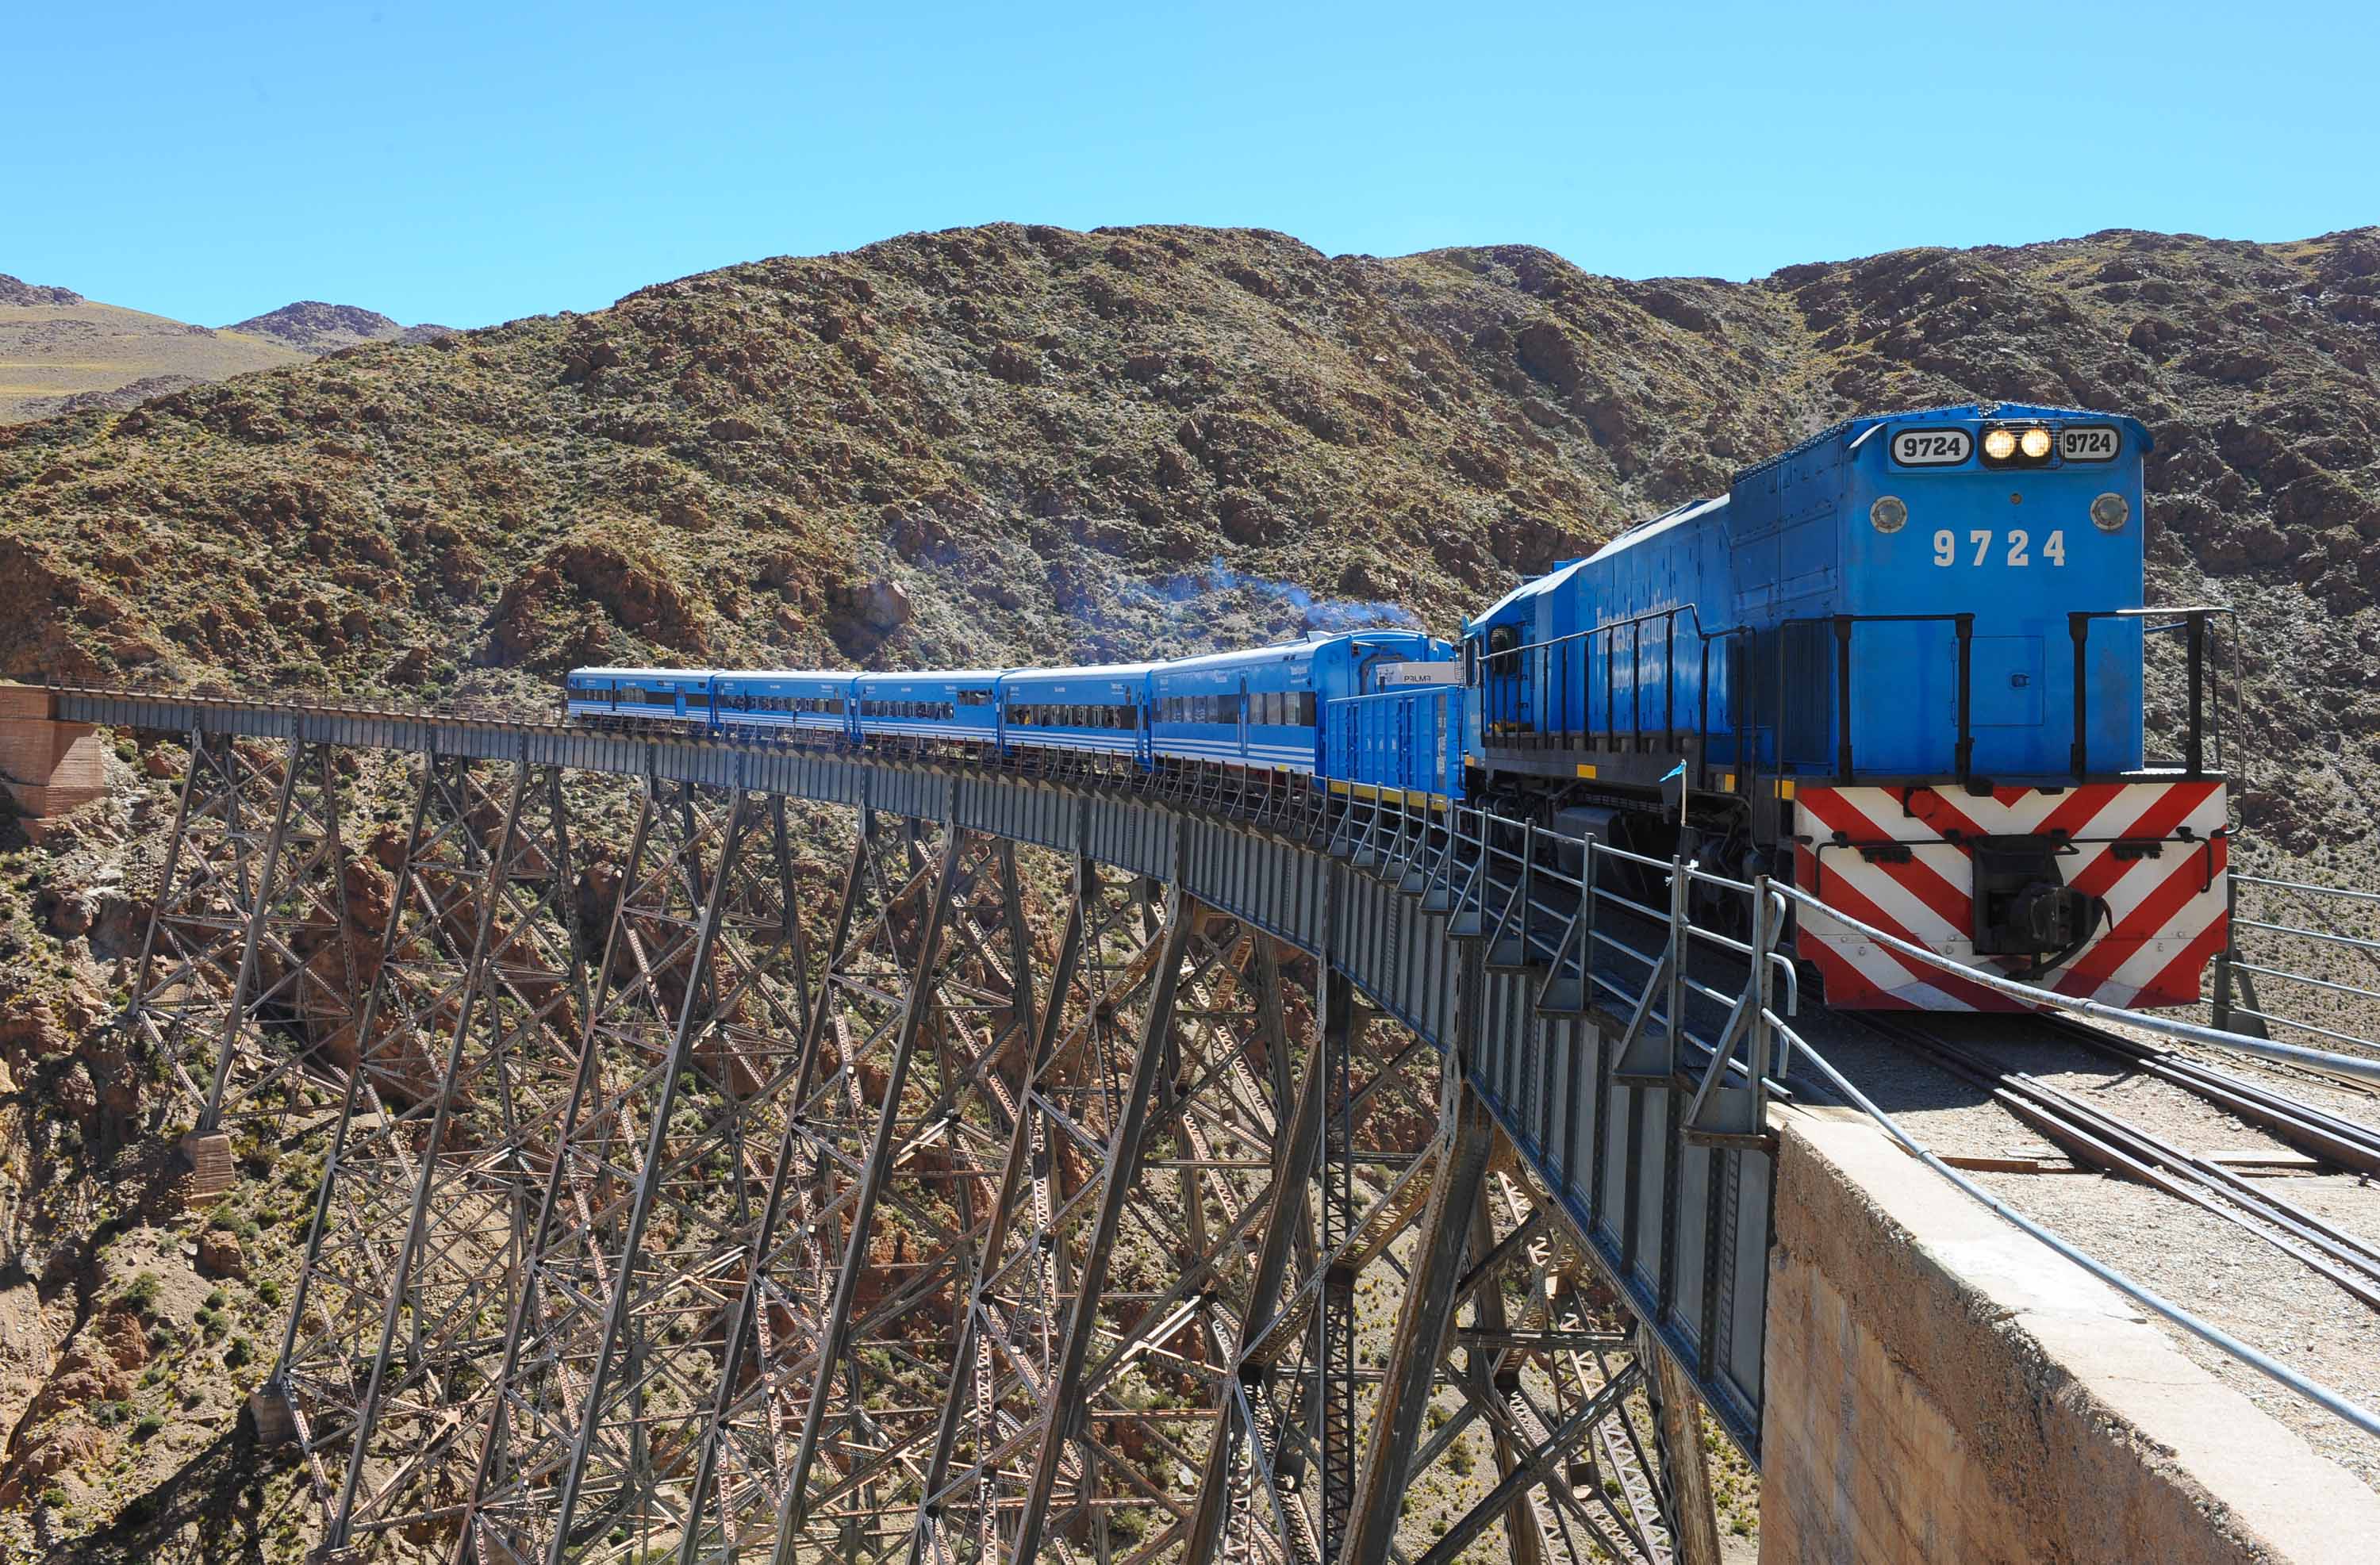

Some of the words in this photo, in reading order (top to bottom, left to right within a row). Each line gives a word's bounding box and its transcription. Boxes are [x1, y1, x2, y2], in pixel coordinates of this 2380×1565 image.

[1903, 436, 1960, 458] 9724
[2066, 432, 2111, 453] 9724
[1933, 529, 2066, 567] 9724
[1626, 595, 1678, 660] Agentins
